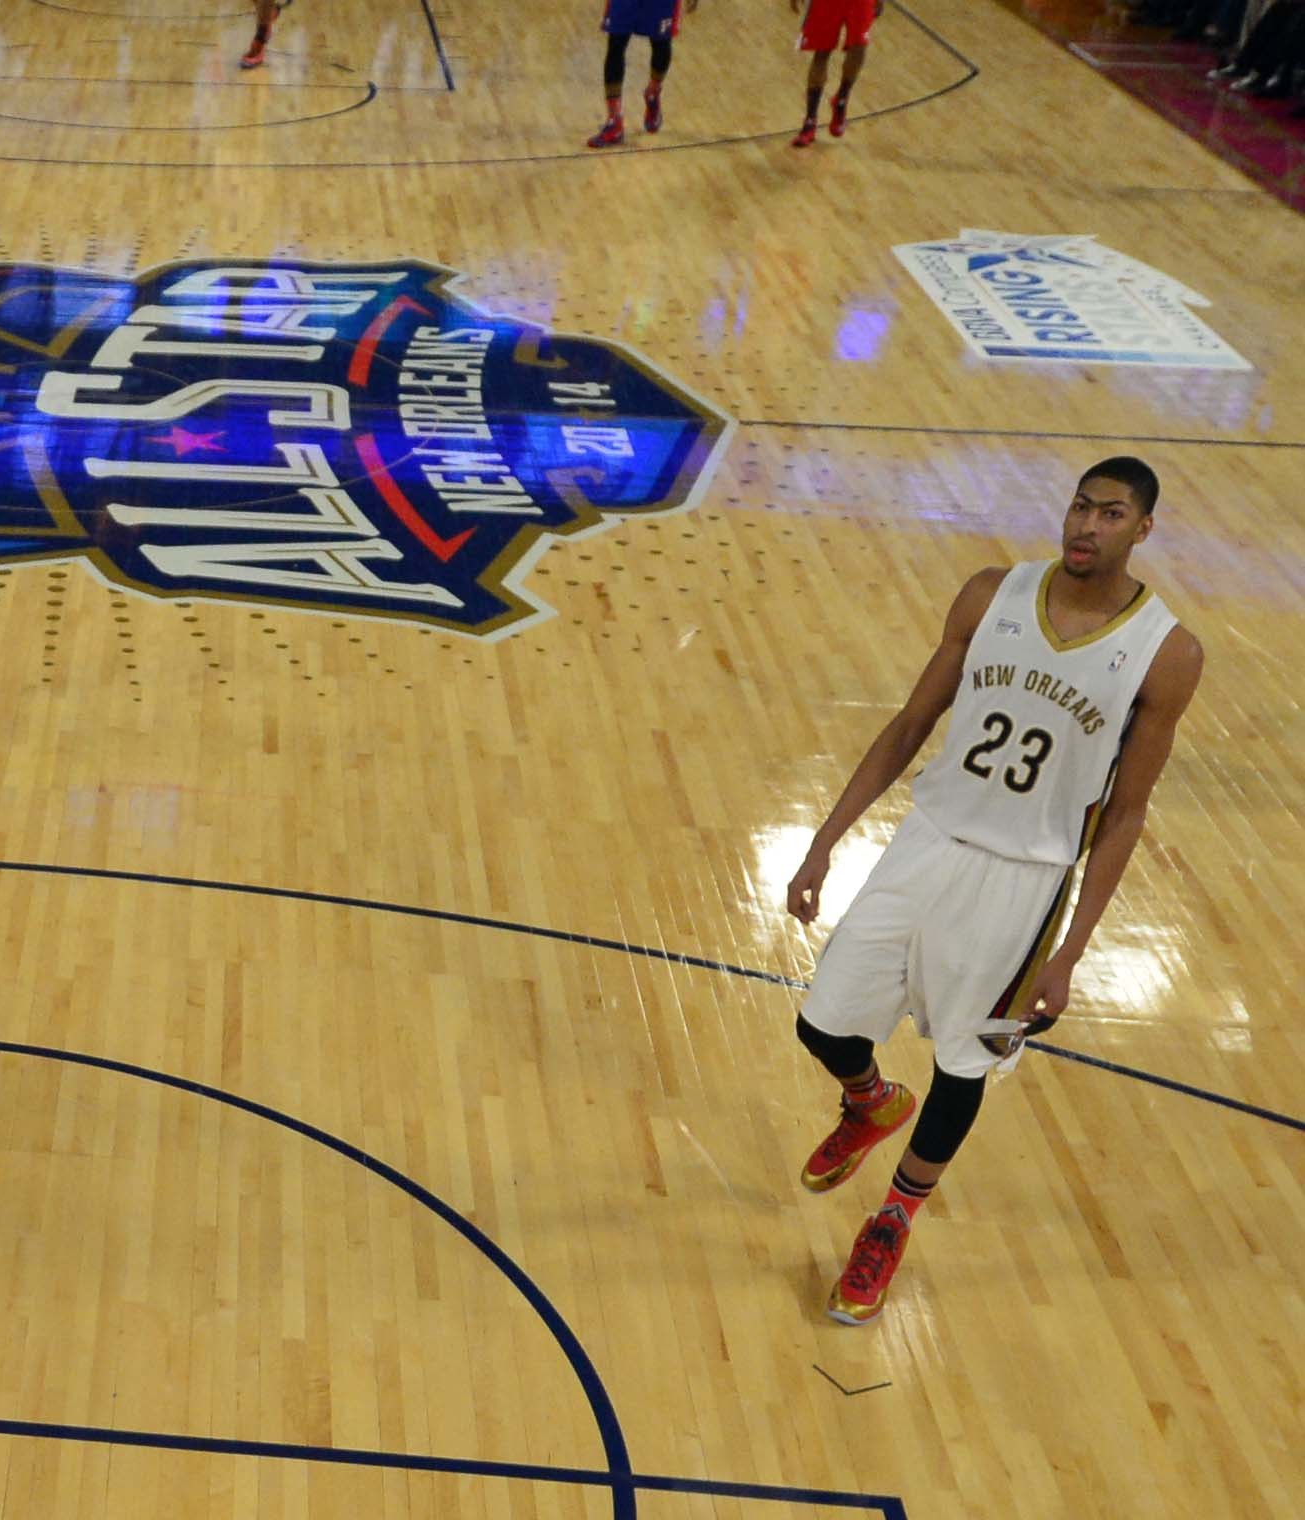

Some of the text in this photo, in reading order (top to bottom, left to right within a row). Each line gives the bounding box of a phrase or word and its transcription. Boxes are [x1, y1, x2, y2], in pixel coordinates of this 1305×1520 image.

[981, 269, 1102, 344] RISING
[399, 325, 543, 517] NEW ORLEANS
[548, 380, 635, 458] 20 14
[972, 664, 1106, 736] NEW ORLEANS
[961, 711, 1055, 794] 23
